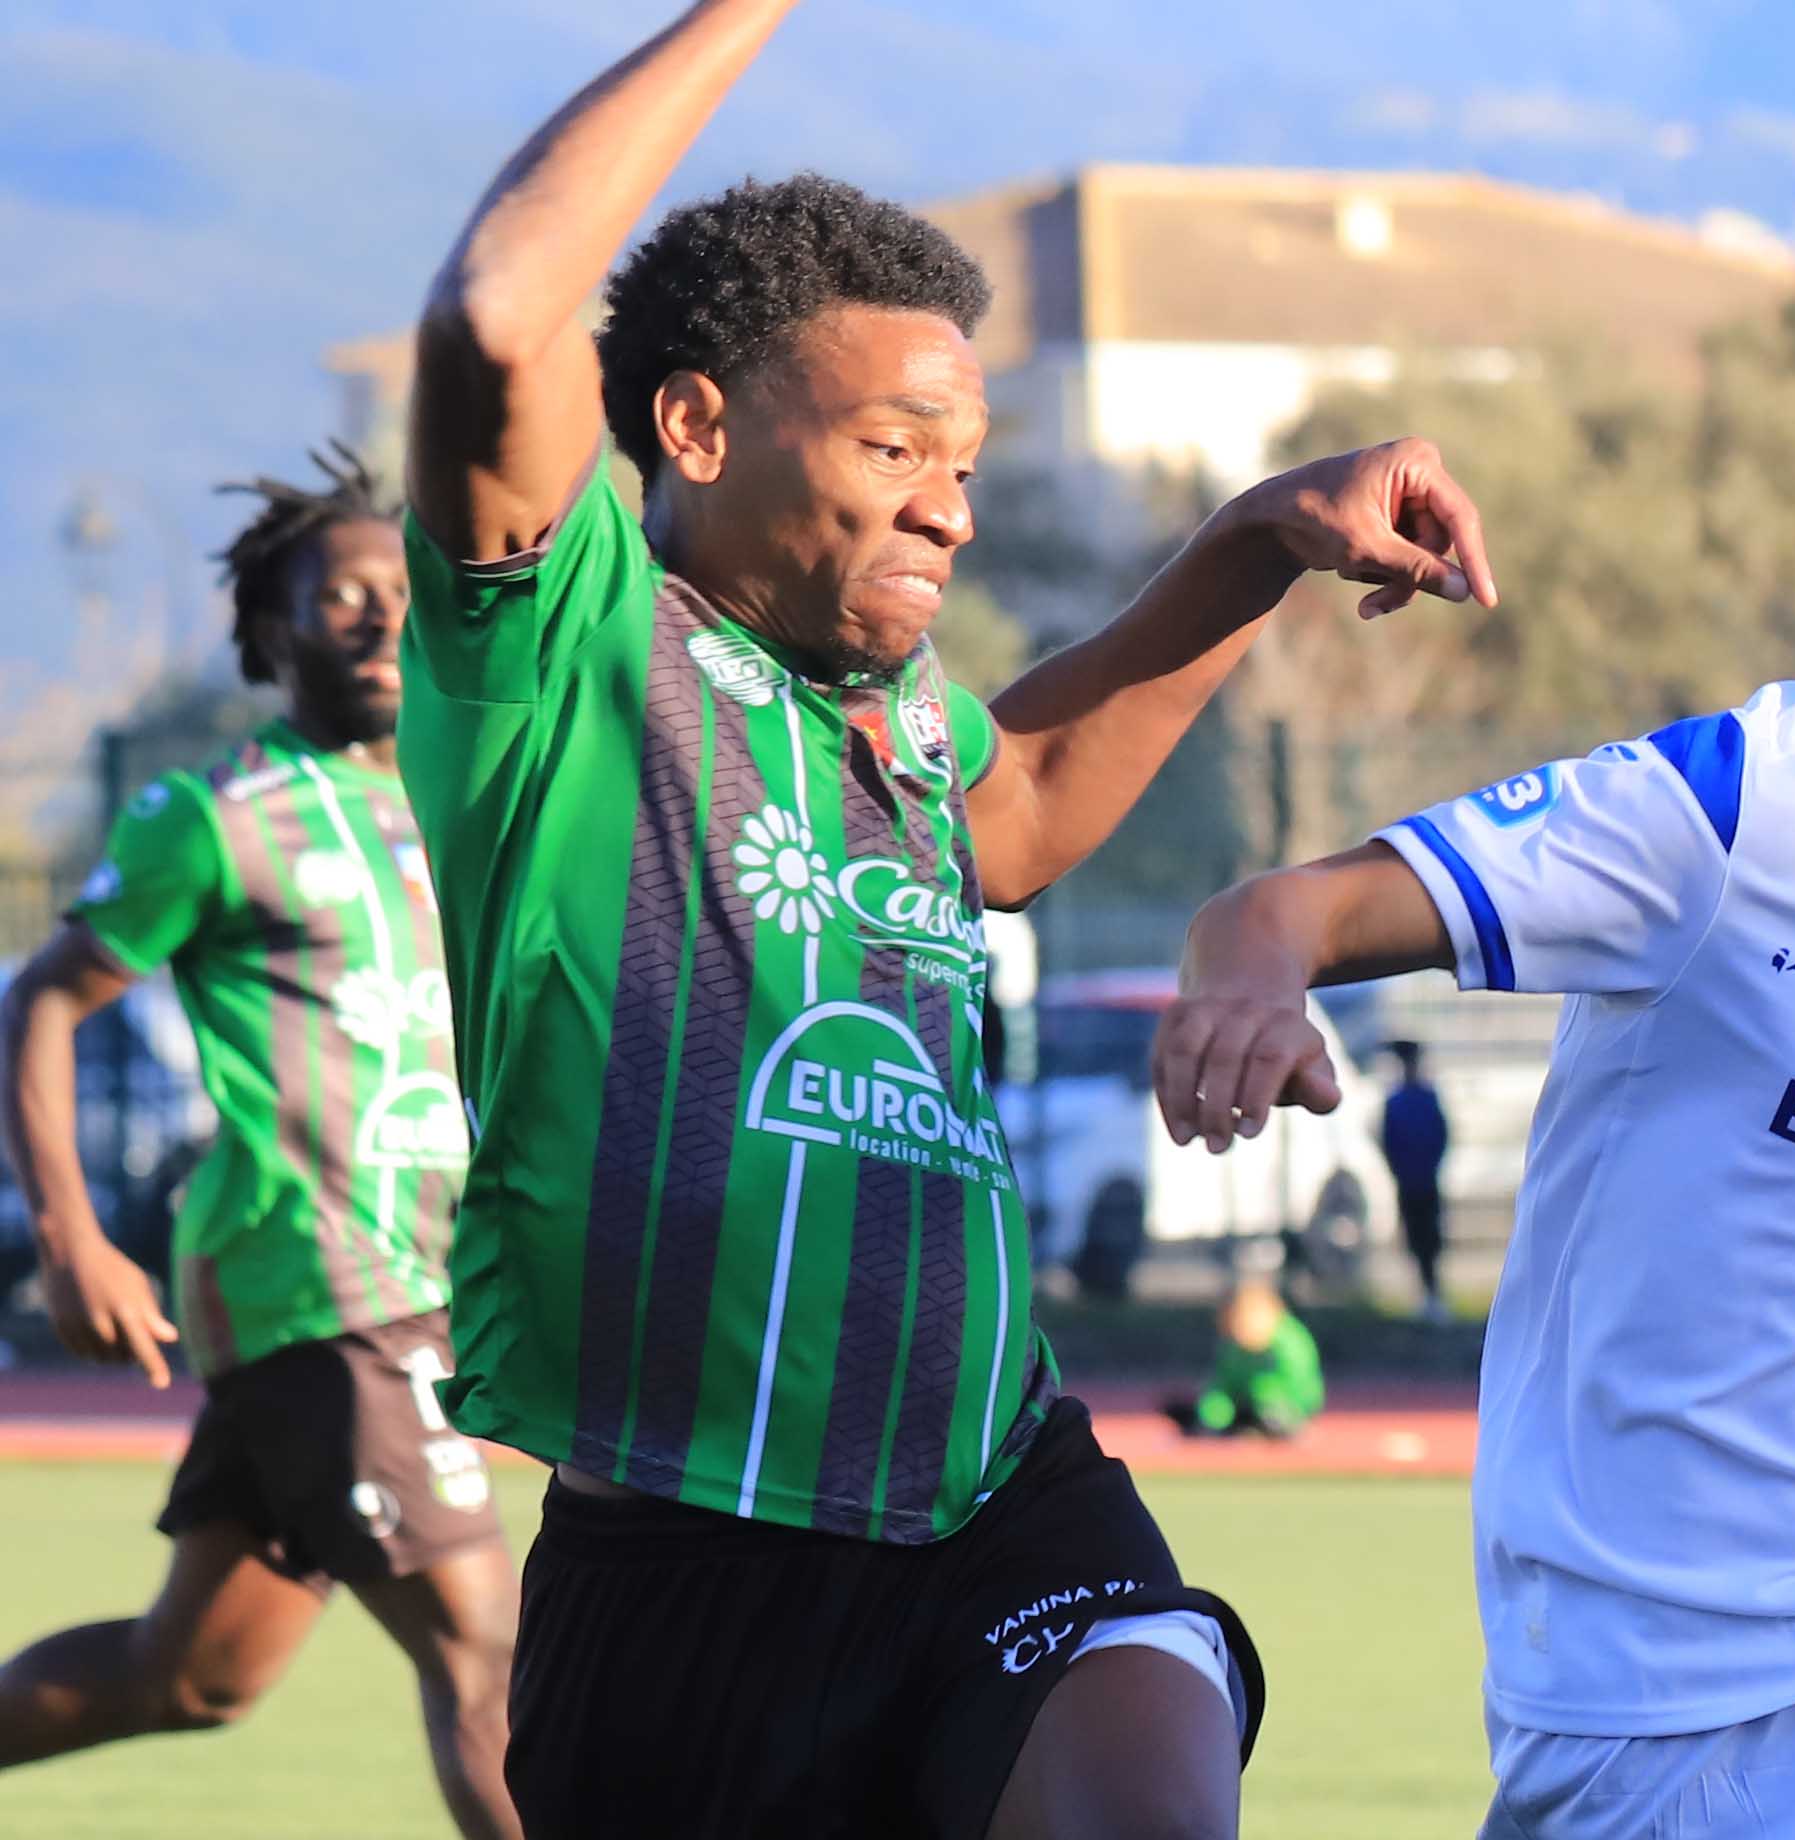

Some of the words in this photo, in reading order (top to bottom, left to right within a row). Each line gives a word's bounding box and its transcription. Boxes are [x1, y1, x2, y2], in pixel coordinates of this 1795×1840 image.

[850, 1127, 932, 1167] location
[984, 1586, 1095, 1645] VANINA
[1104, 1579, 1145, 1597] PA
